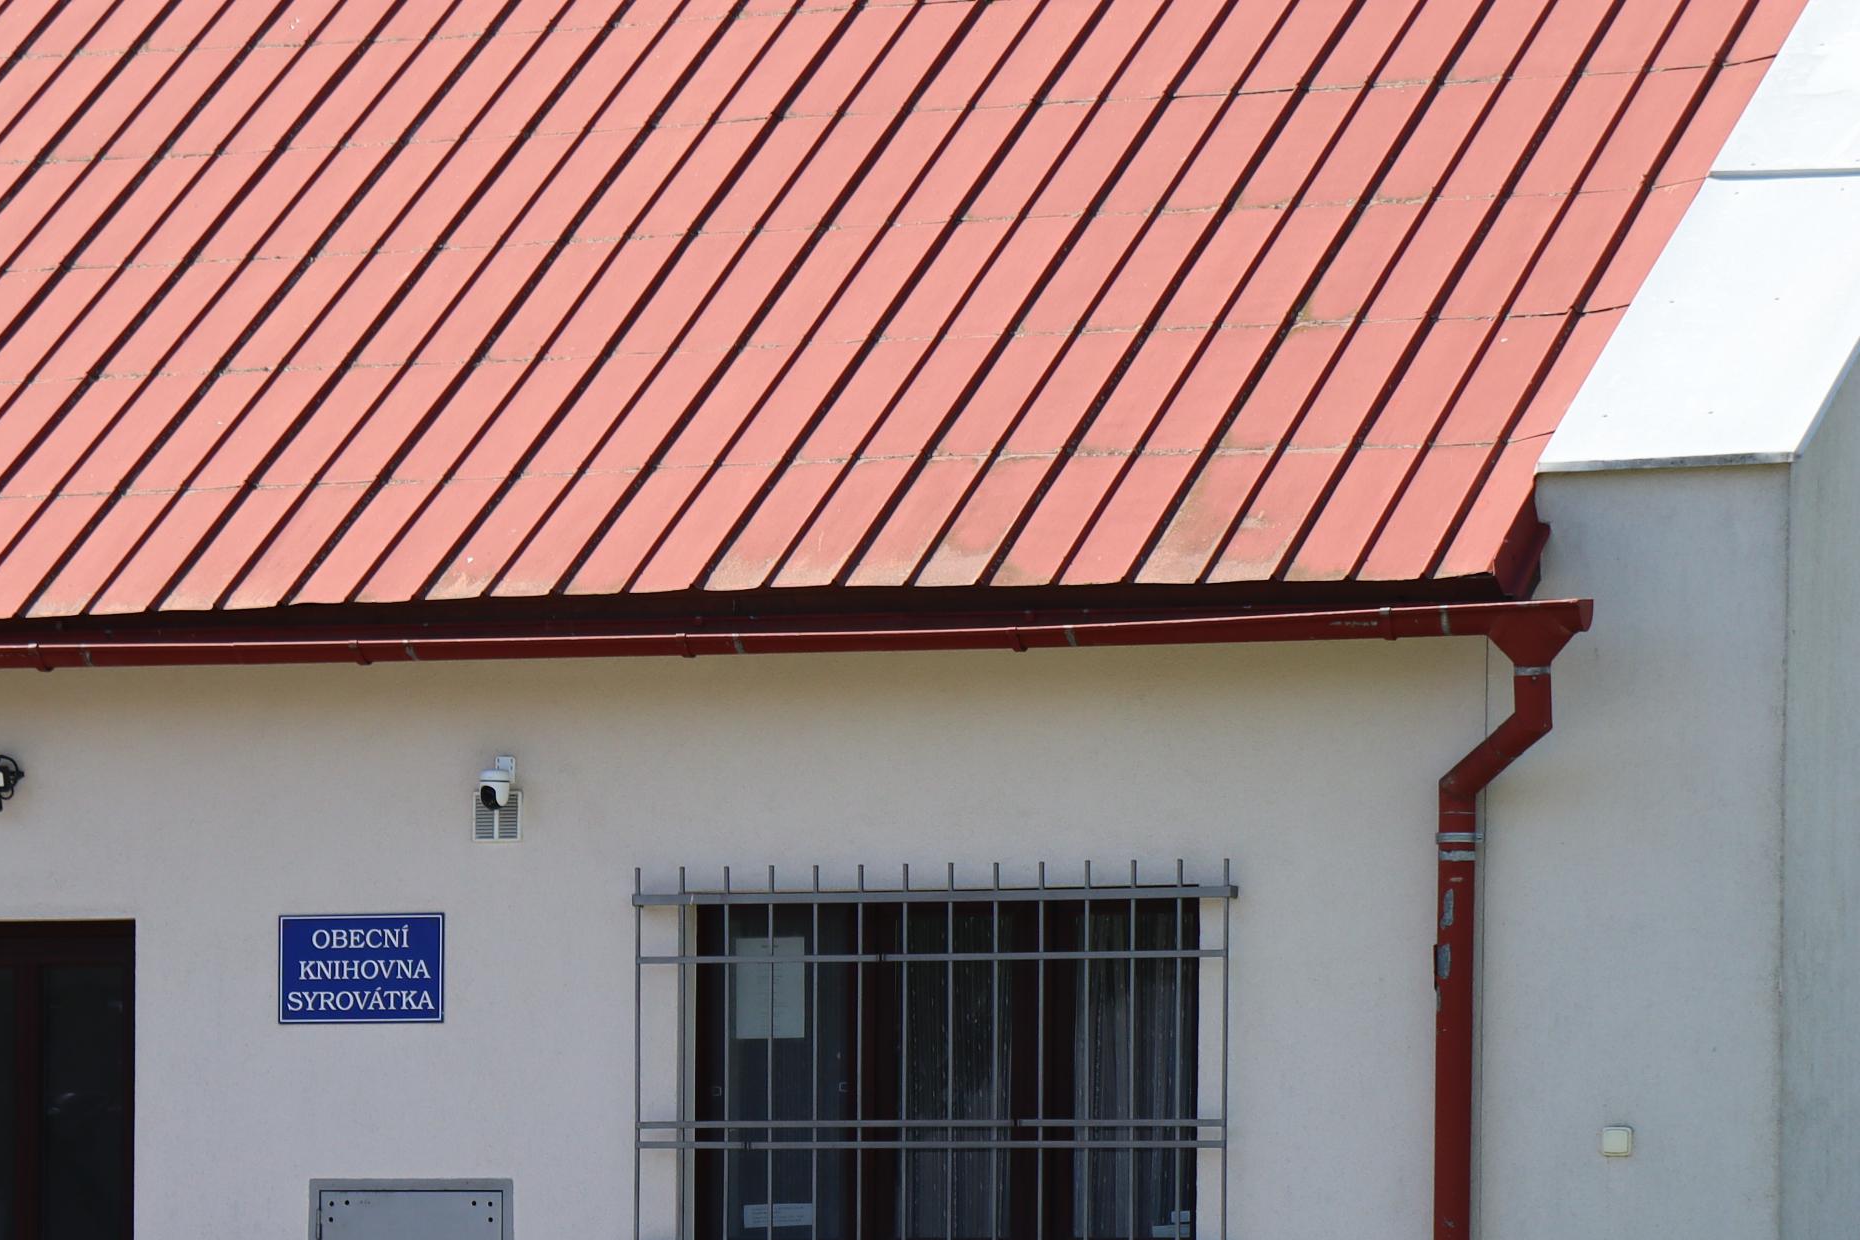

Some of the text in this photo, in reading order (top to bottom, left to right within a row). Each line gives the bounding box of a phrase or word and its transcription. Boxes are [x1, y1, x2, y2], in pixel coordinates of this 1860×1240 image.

[312, 924, 409, 949] OBECNÍ
[299, 959, 431, 980] KNIHOVNA
[287, 987, 435, 1012] SYROVÁTKA
